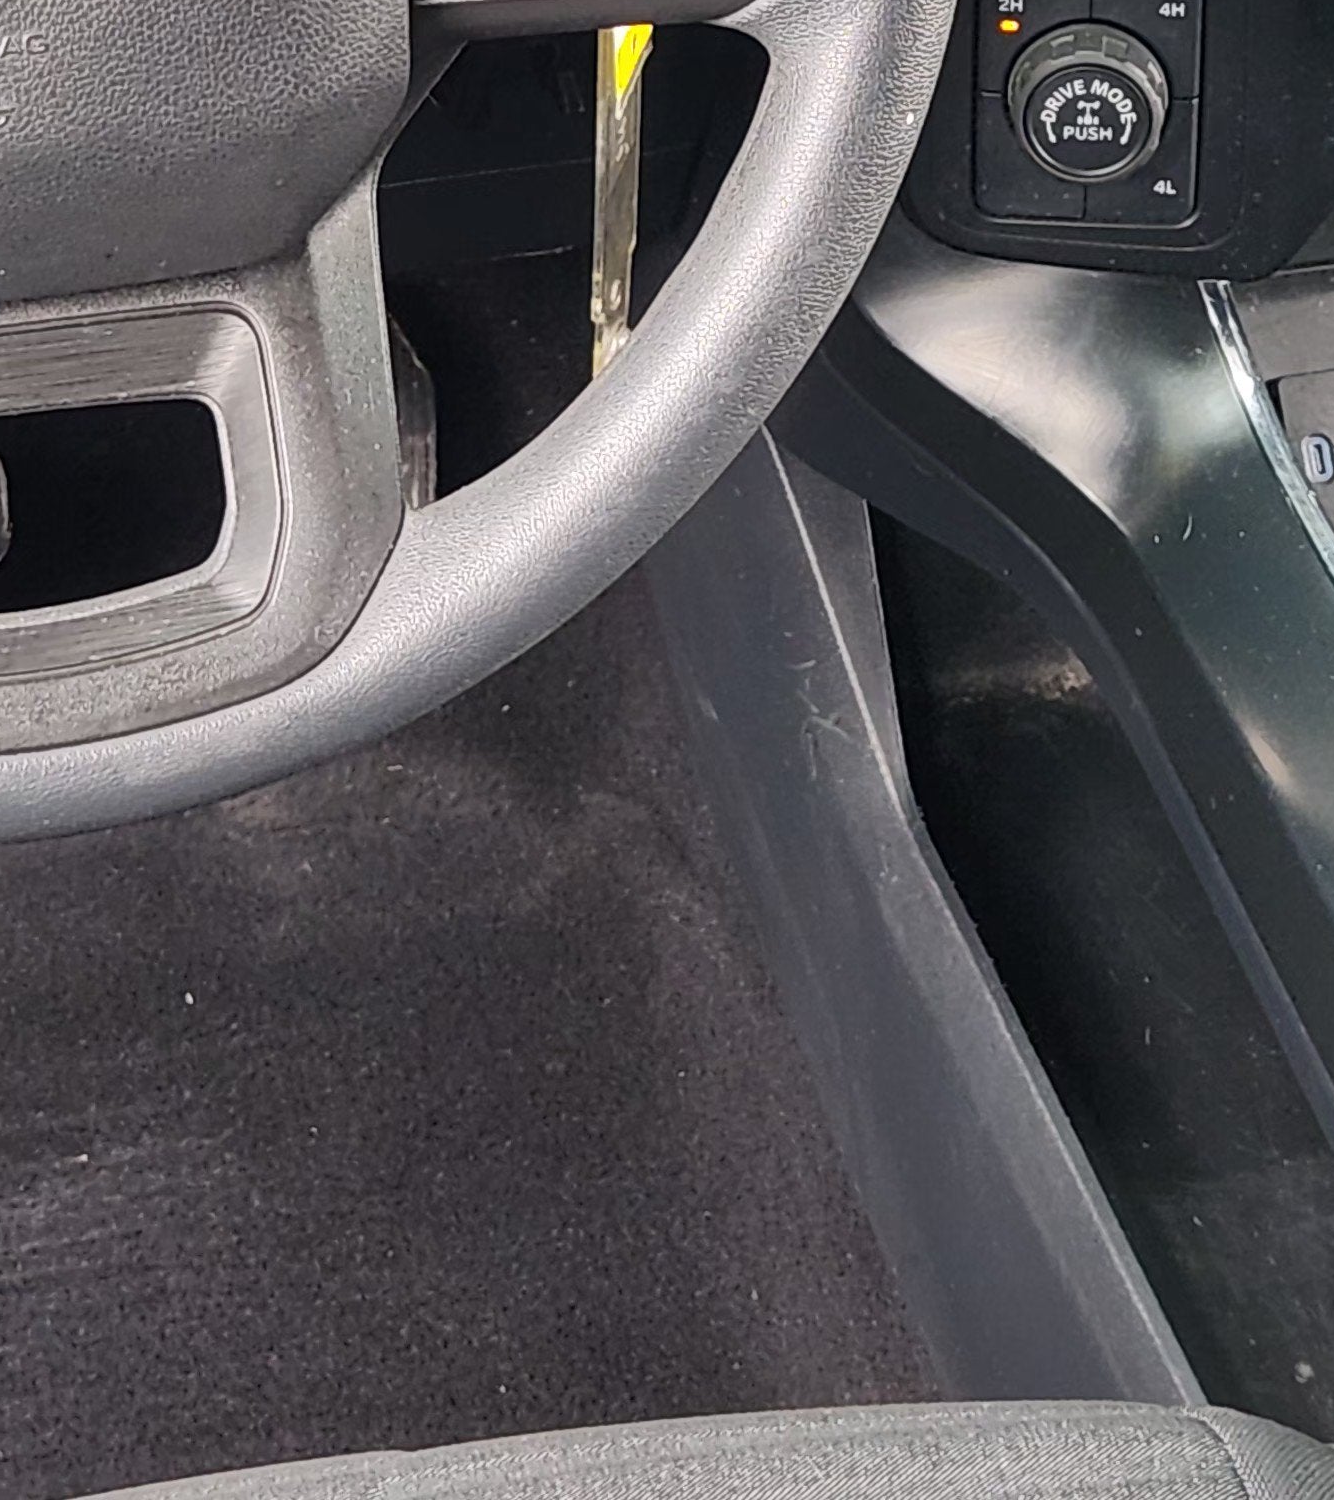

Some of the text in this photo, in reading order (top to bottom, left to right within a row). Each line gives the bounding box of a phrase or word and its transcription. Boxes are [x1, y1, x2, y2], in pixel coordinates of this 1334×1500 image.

[1158, 3, 1185, 18] 4H
[1040, 79, 1138, 123] DRIVE MODE
[1063, 125, 1113, 142] PUSH
[1153, 180, 1177, 195] 4L
